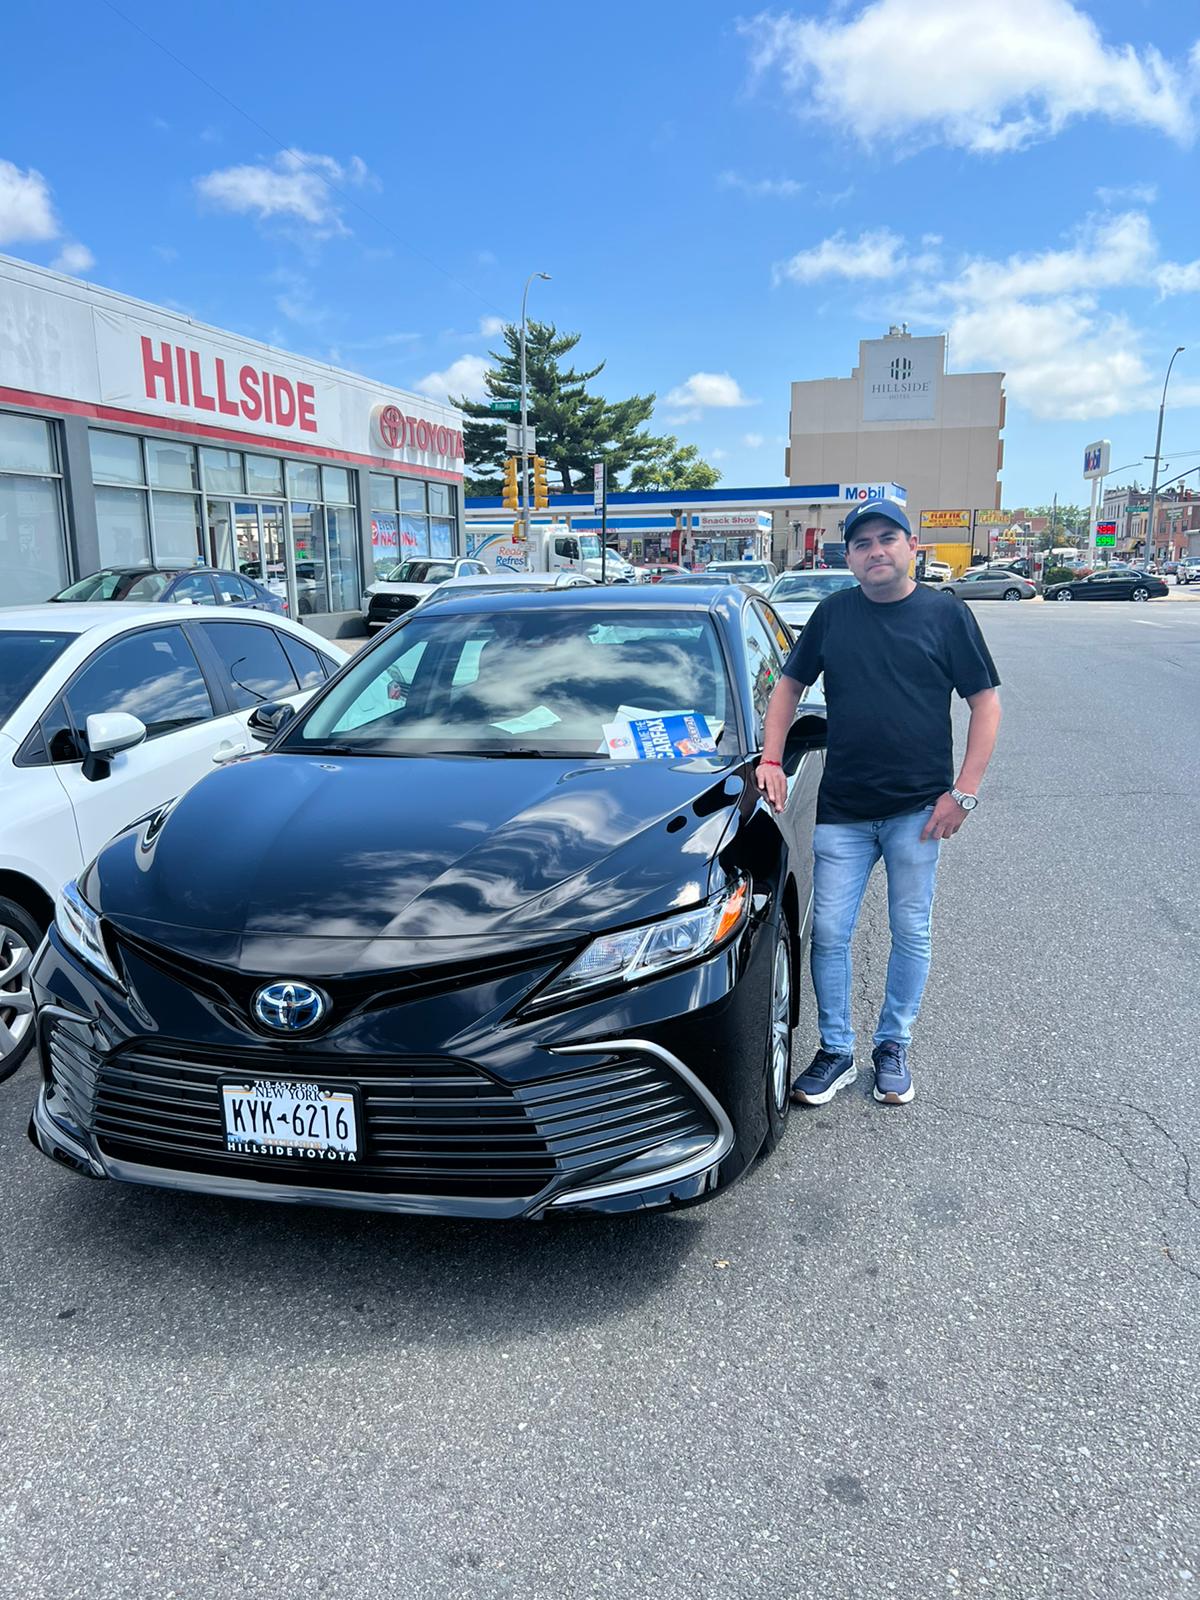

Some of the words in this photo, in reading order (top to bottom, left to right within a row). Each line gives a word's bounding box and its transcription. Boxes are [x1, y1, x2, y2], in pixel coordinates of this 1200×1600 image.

[140, 336, 318, 433] HILLSIDE
[872, 382, 929, 394] HILLSIDE
[407, 415, 465, 460] TOYOTA
[1084, 447, 1101, 473] Mobil
[845, 484, 885, 500] Mobil
[702, 516, 730, 525] Snack
[732, 515, 756, 525] Shop
[380, 531, 418, 547] NACNAL
[645, 718, 675, 759] CARFAX
[254, 1080, 319, 1092] 718-657-5500
[255, 1087, 284, 1100] NEW
[289, 1089, 324, 1102] YORK
[231, 1099, 275, 1135] KYK
[292, 1103, 349, 1140] 6216
[227, 1142, 293, 1157] HILLSIDE
[297, 1147, 357, 1162] TOYOTA
